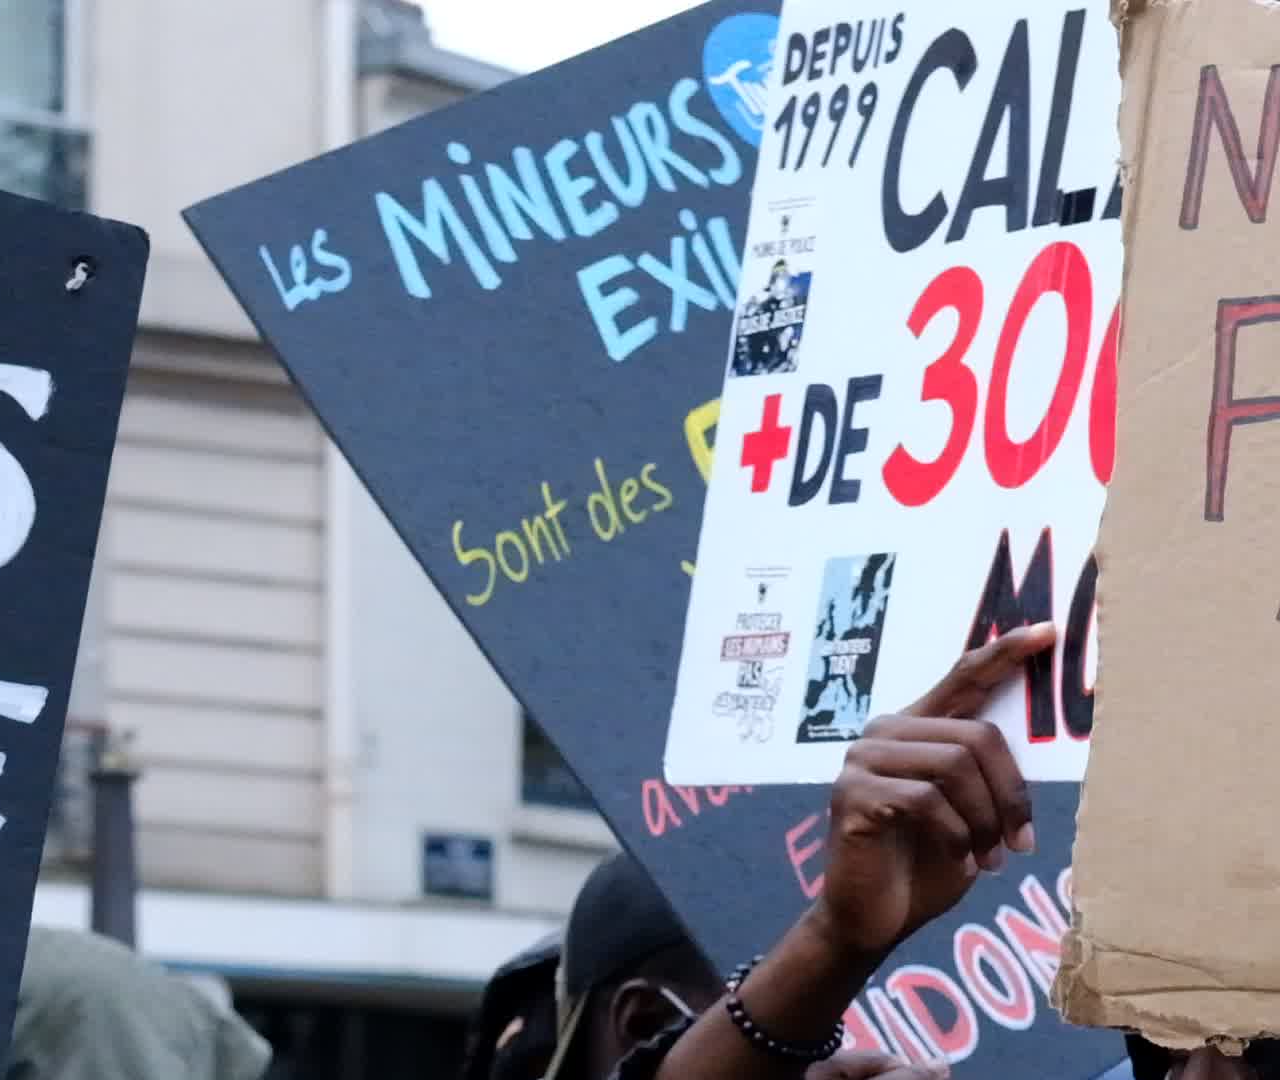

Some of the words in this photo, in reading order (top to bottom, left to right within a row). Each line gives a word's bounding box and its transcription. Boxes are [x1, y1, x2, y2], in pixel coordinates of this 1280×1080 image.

[782, 13, 904, 86] DEPUIS
[774, 82, 878, 171] 1999
[881, 8, 1122, 253] CAL
[453, 481, 570, 605] Sont
[587, 457, 673, 541] des
